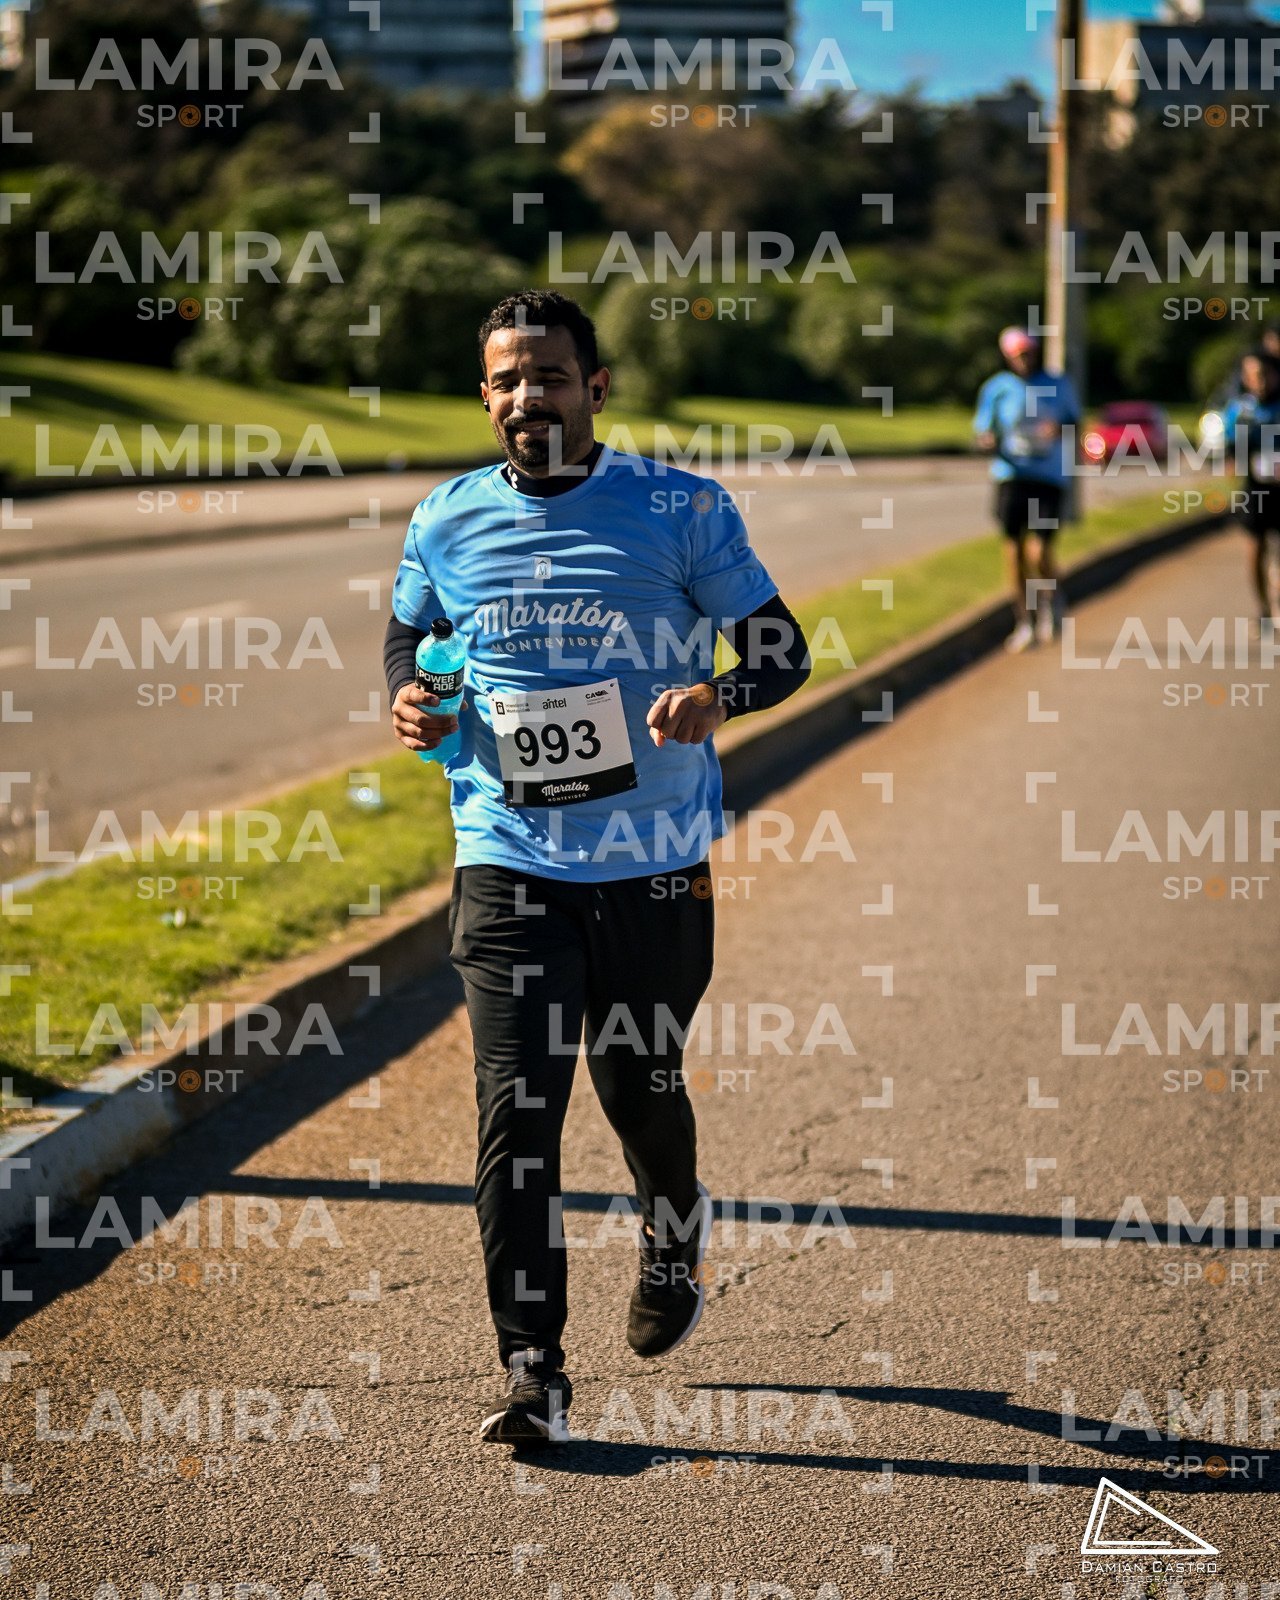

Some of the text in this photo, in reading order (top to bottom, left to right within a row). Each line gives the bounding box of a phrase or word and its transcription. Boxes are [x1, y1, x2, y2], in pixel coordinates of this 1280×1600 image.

[474, 597, 628, 638] Maratón
[490, 635, 616, 654] MONTEVIDEO
[419, 669, 455, 684] POWER
[433, 681, 455, 691] ADE
[542, 697, 567, 710] antel
[513, 719, 602, 768] 993
[541, 780, 590, 797] Maratón
[547, 792, 587, 802] MONTEVIDEO
